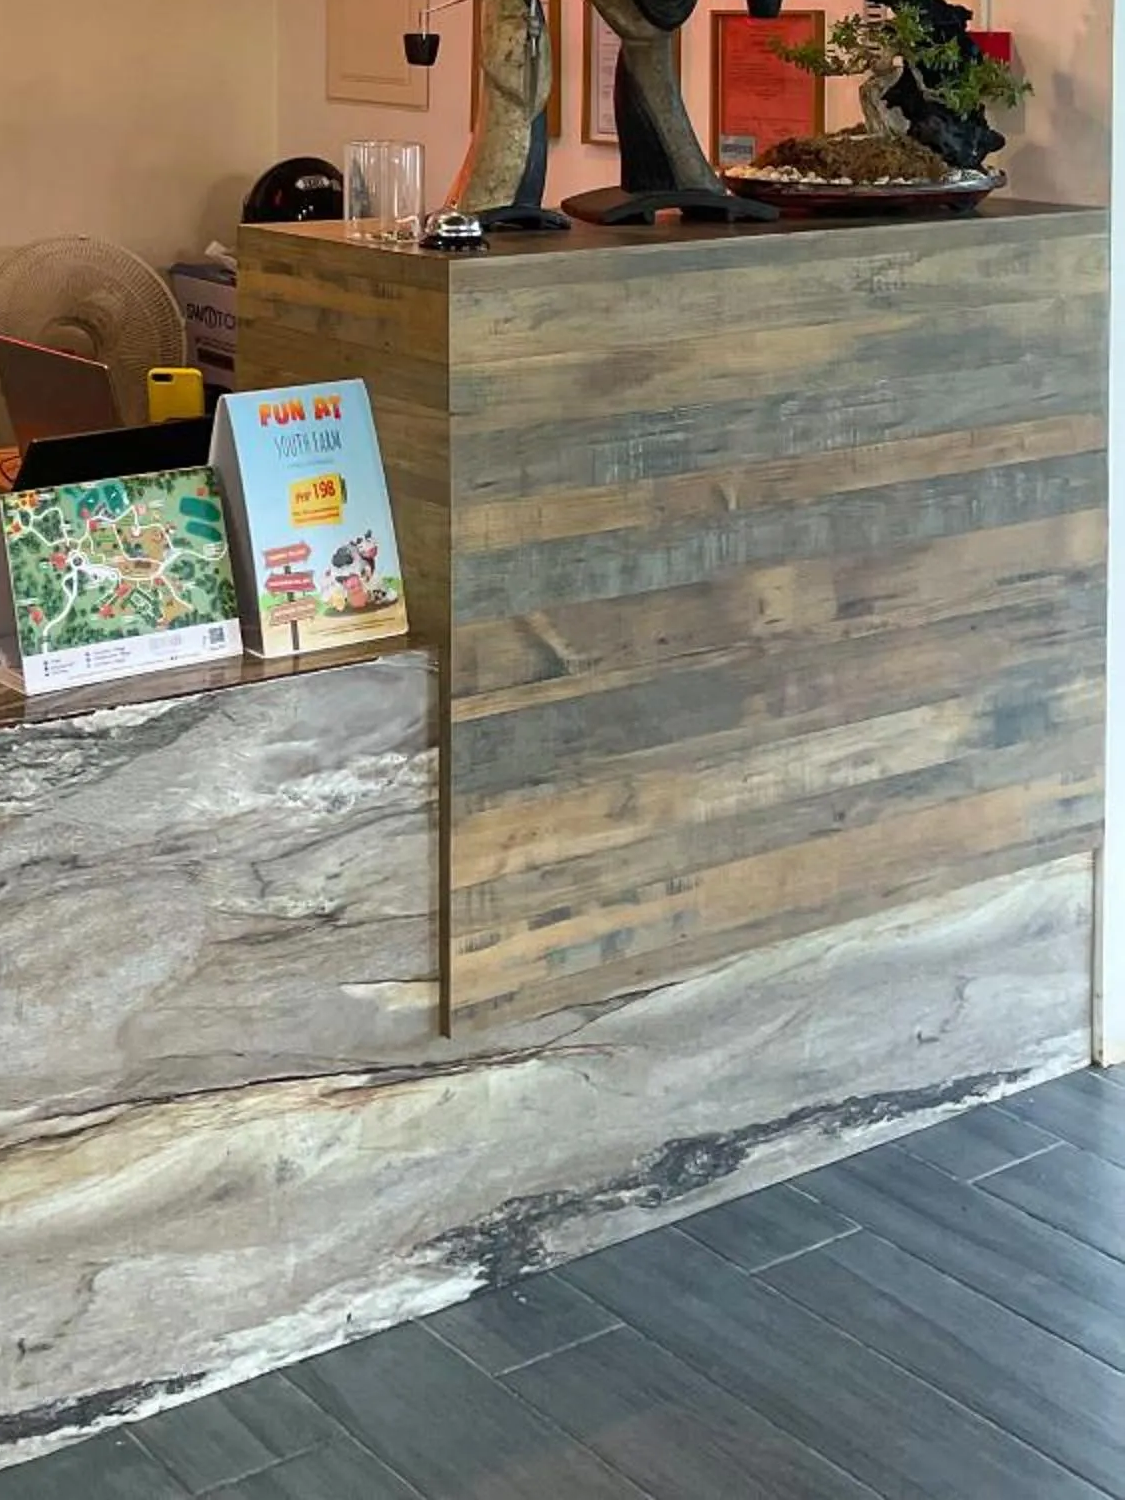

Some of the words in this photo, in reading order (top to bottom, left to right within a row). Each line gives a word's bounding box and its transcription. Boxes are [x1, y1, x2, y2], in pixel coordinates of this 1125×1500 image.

[259, 398, 305, 427] FUN
[314, 395, 342, 420] AT
[312, 429, 342, 453] FARM
[312, 479, 336, 499] 198
